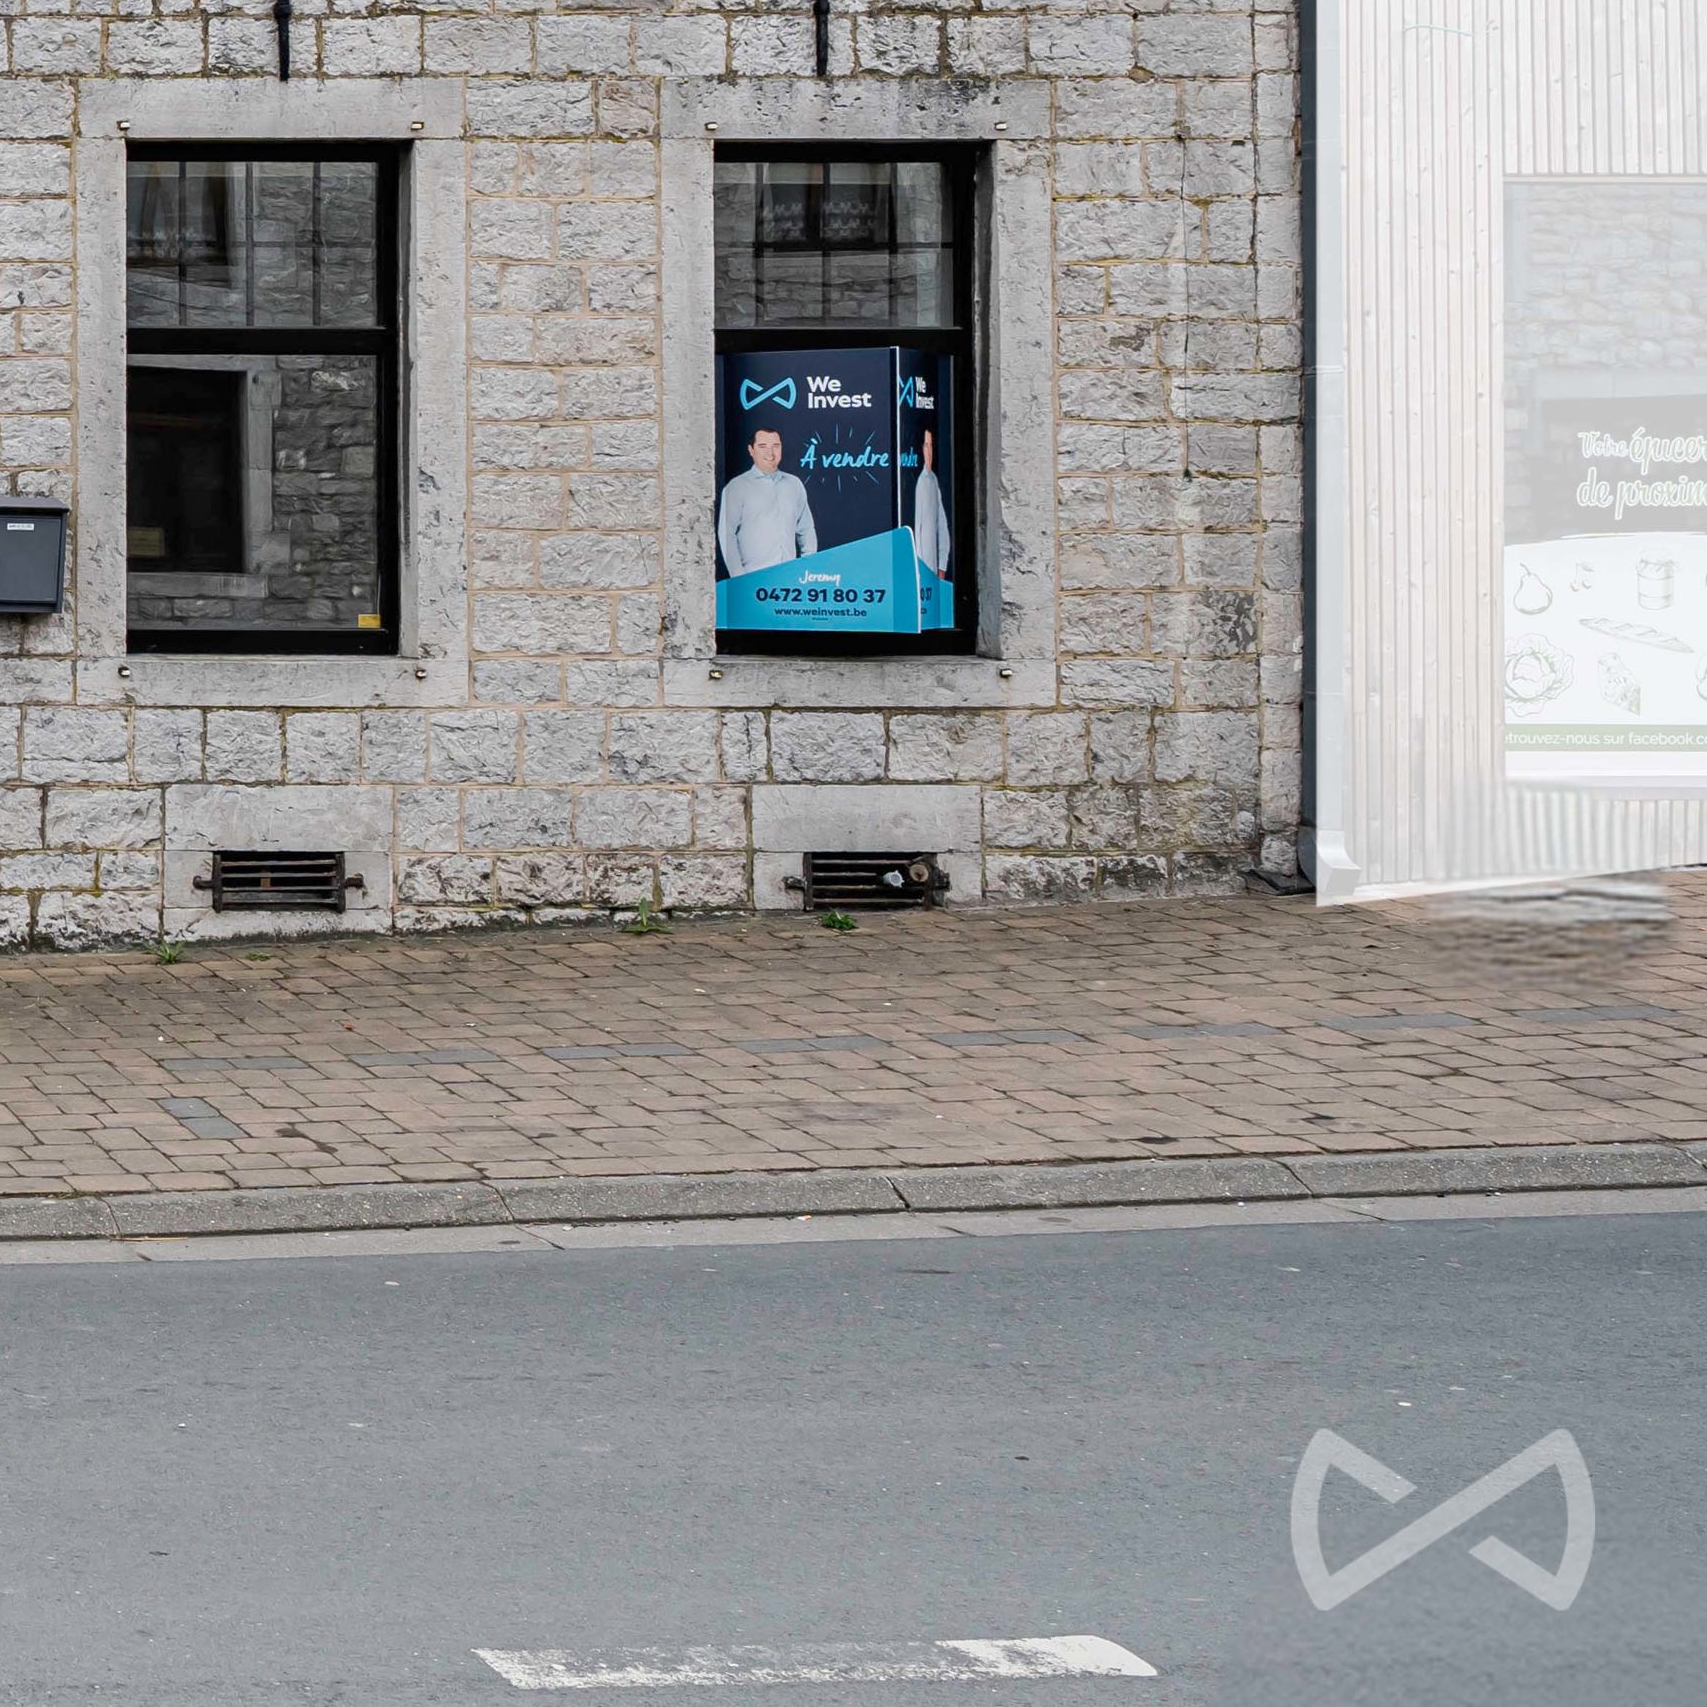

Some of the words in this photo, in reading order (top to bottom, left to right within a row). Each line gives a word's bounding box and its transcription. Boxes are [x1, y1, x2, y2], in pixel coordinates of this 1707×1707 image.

[806, 376, 842, 393] We
[807, 392, 872, 410] Invest
[800, 437, 818, 469] À
[822, 445, 890, 468] vendre
[1577, 431, 1628, 459] Votre
[1576, 467, 1614, 508] de
[798, 570, 842, 587] Jeremy
[756, 588, 803, 602] 0472
[807, 588, 827, 602] 91
[833, 588, 857, 603] 80
[863, 589, 886, 603] 37
[774, 607, 867, 617] www.weinvest.be
[1505, 733, 1600, 744] trouvez-nous
[1604, 735, 1625, 744] sur
